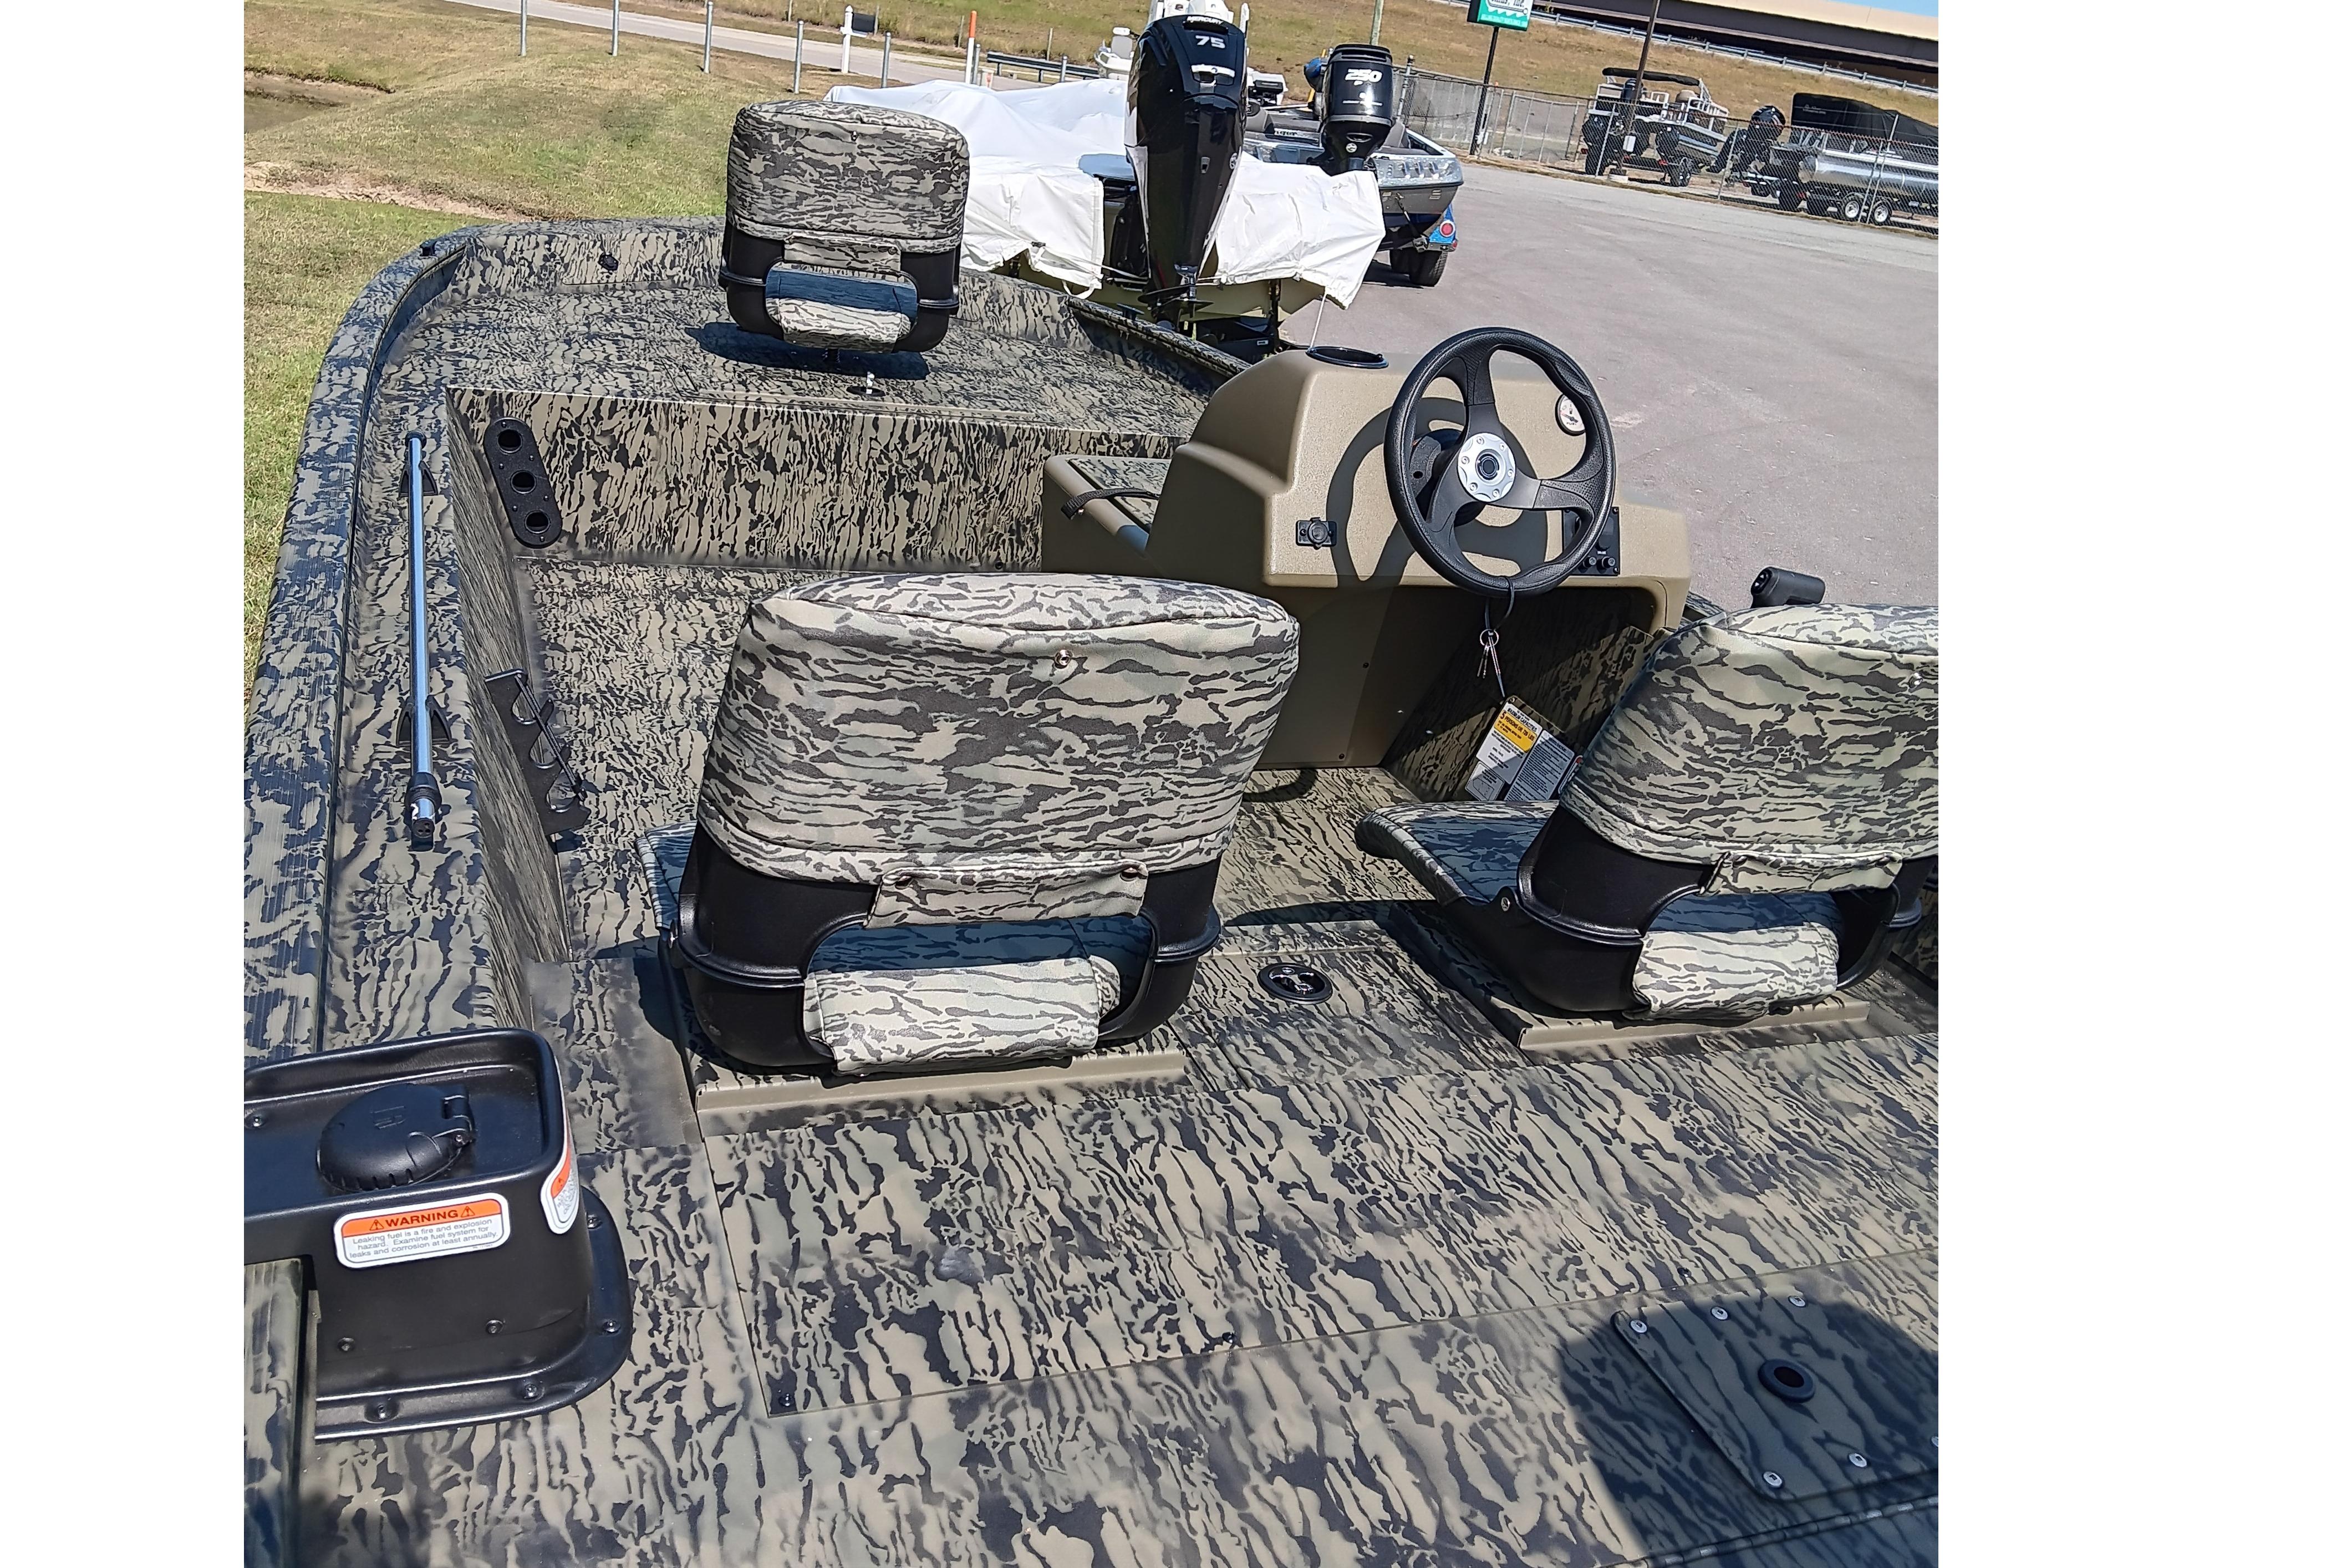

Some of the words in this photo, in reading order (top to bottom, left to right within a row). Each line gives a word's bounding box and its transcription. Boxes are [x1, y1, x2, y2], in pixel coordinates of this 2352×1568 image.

[1187, 16, 1224, 24] MERCURY
[1195, 35, 1225, 49] 75
[1345, 69, 1382, 83] 250
[1500, 711, 1506, 719] 5
[385, 1210, 458, 1227] WARNING
[353, 1235, 385, 1244] Leaking
[454, 1219, 492, 1229] explosion
[358, 1242, 388, 1250] hazard.
[393, 1235, 429, 1245] Examine
[431, 1232, 445, 1240] fuel
[447, 1228, 476, 1238] system
[391, 1243, 430, 1252] corrosion
[463, 1231, 498, 1241] annually.
